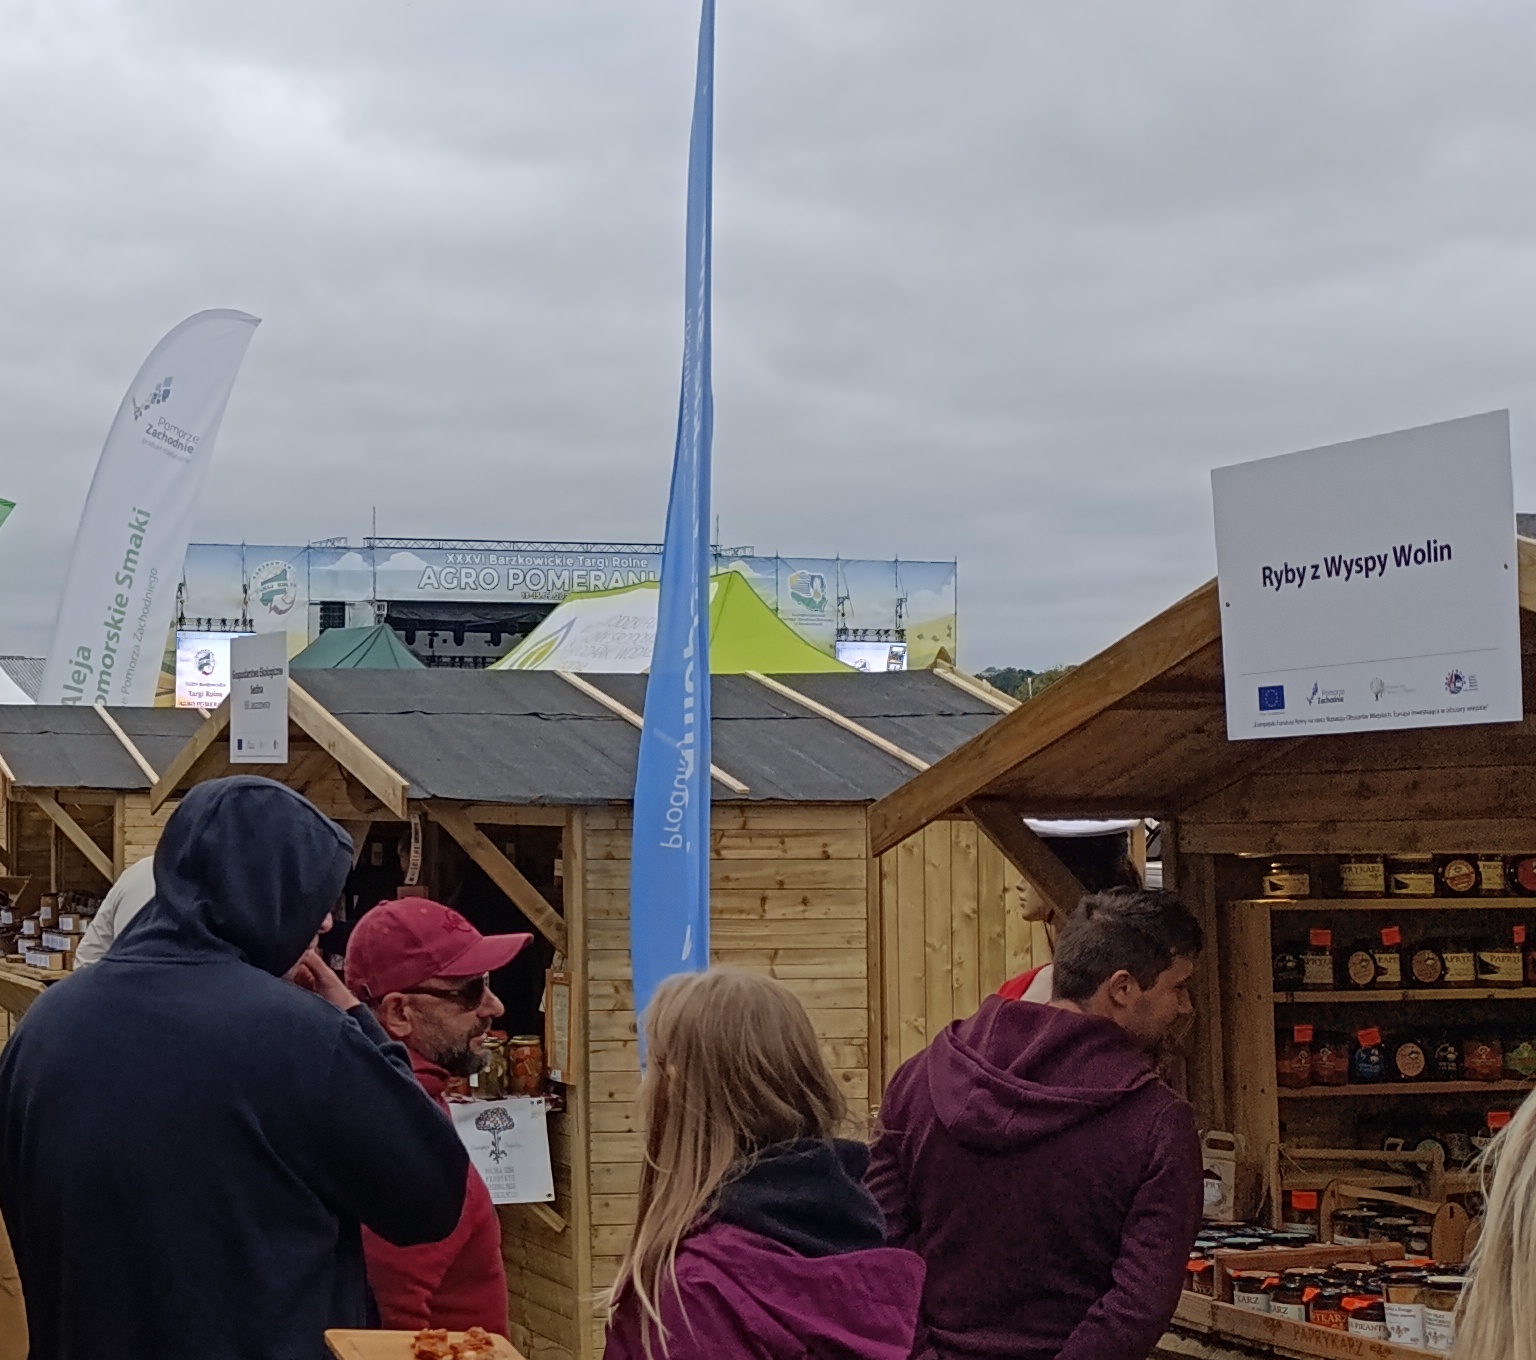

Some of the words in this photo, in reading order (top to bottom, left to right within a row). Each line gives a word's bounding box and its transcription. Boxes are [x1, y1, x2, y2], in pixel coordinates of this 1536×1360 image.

[145, 423, 195, 454] Zachodnie
[157, 416, 200, 444] Pomorze
[446, 553, 485, 565] XXXVI
[489, 554, 574, 568] Barzkowickie
[578, 556, 609, 570] Targi
[613, 557, 649, 569] Rolne
[1262, 561, 1307, 592] Ryby
[1310, 563, 1321, 581] z
[1323, 553, 1389, 583] Wyspy
[1392, 538, 1453, 569] Wolin
[417, 566, 500, 591] AGRO
[507, 567, 660, 592] POMERANI
[93, 592, 130, 706] omorskie
[115, 506, 152, 590] Smaki
[121, 643, 141, 696] Pomorza
[132, 567, 159, 643] Zachodniego
[1236, 1294, 1260, 1305] KARZ
[1292, 1324, 1364, 1357] PAPRYKARZ
